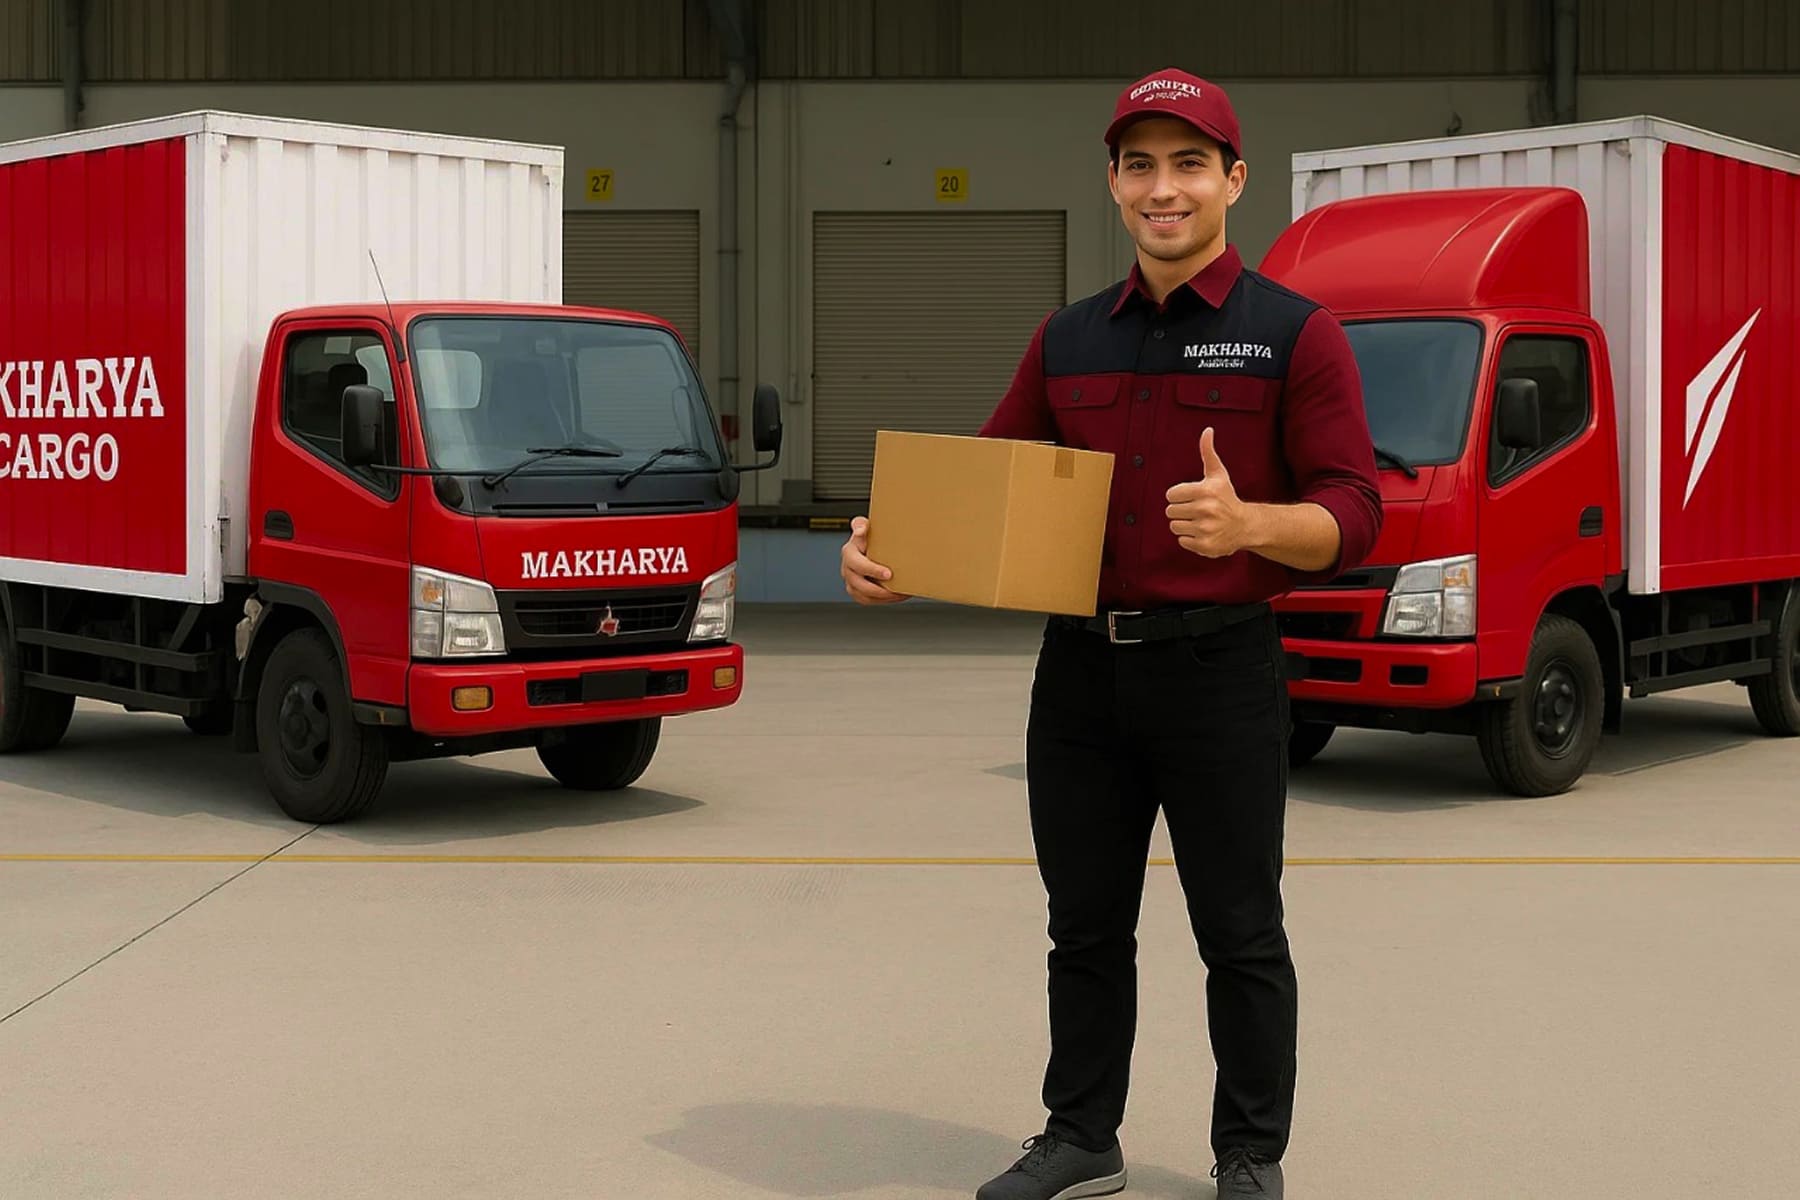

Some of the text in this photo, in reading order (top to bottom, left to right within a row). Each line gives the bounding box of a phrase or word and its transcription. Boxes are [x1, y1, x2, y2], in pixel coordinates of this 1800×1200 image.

[591, 174, 610, 193] 27
[941, 175, 959, 193] 20
[1183, 342, 1273, 359] MAKHARYA
[520, 546, 690, 580] MAKHARYA
